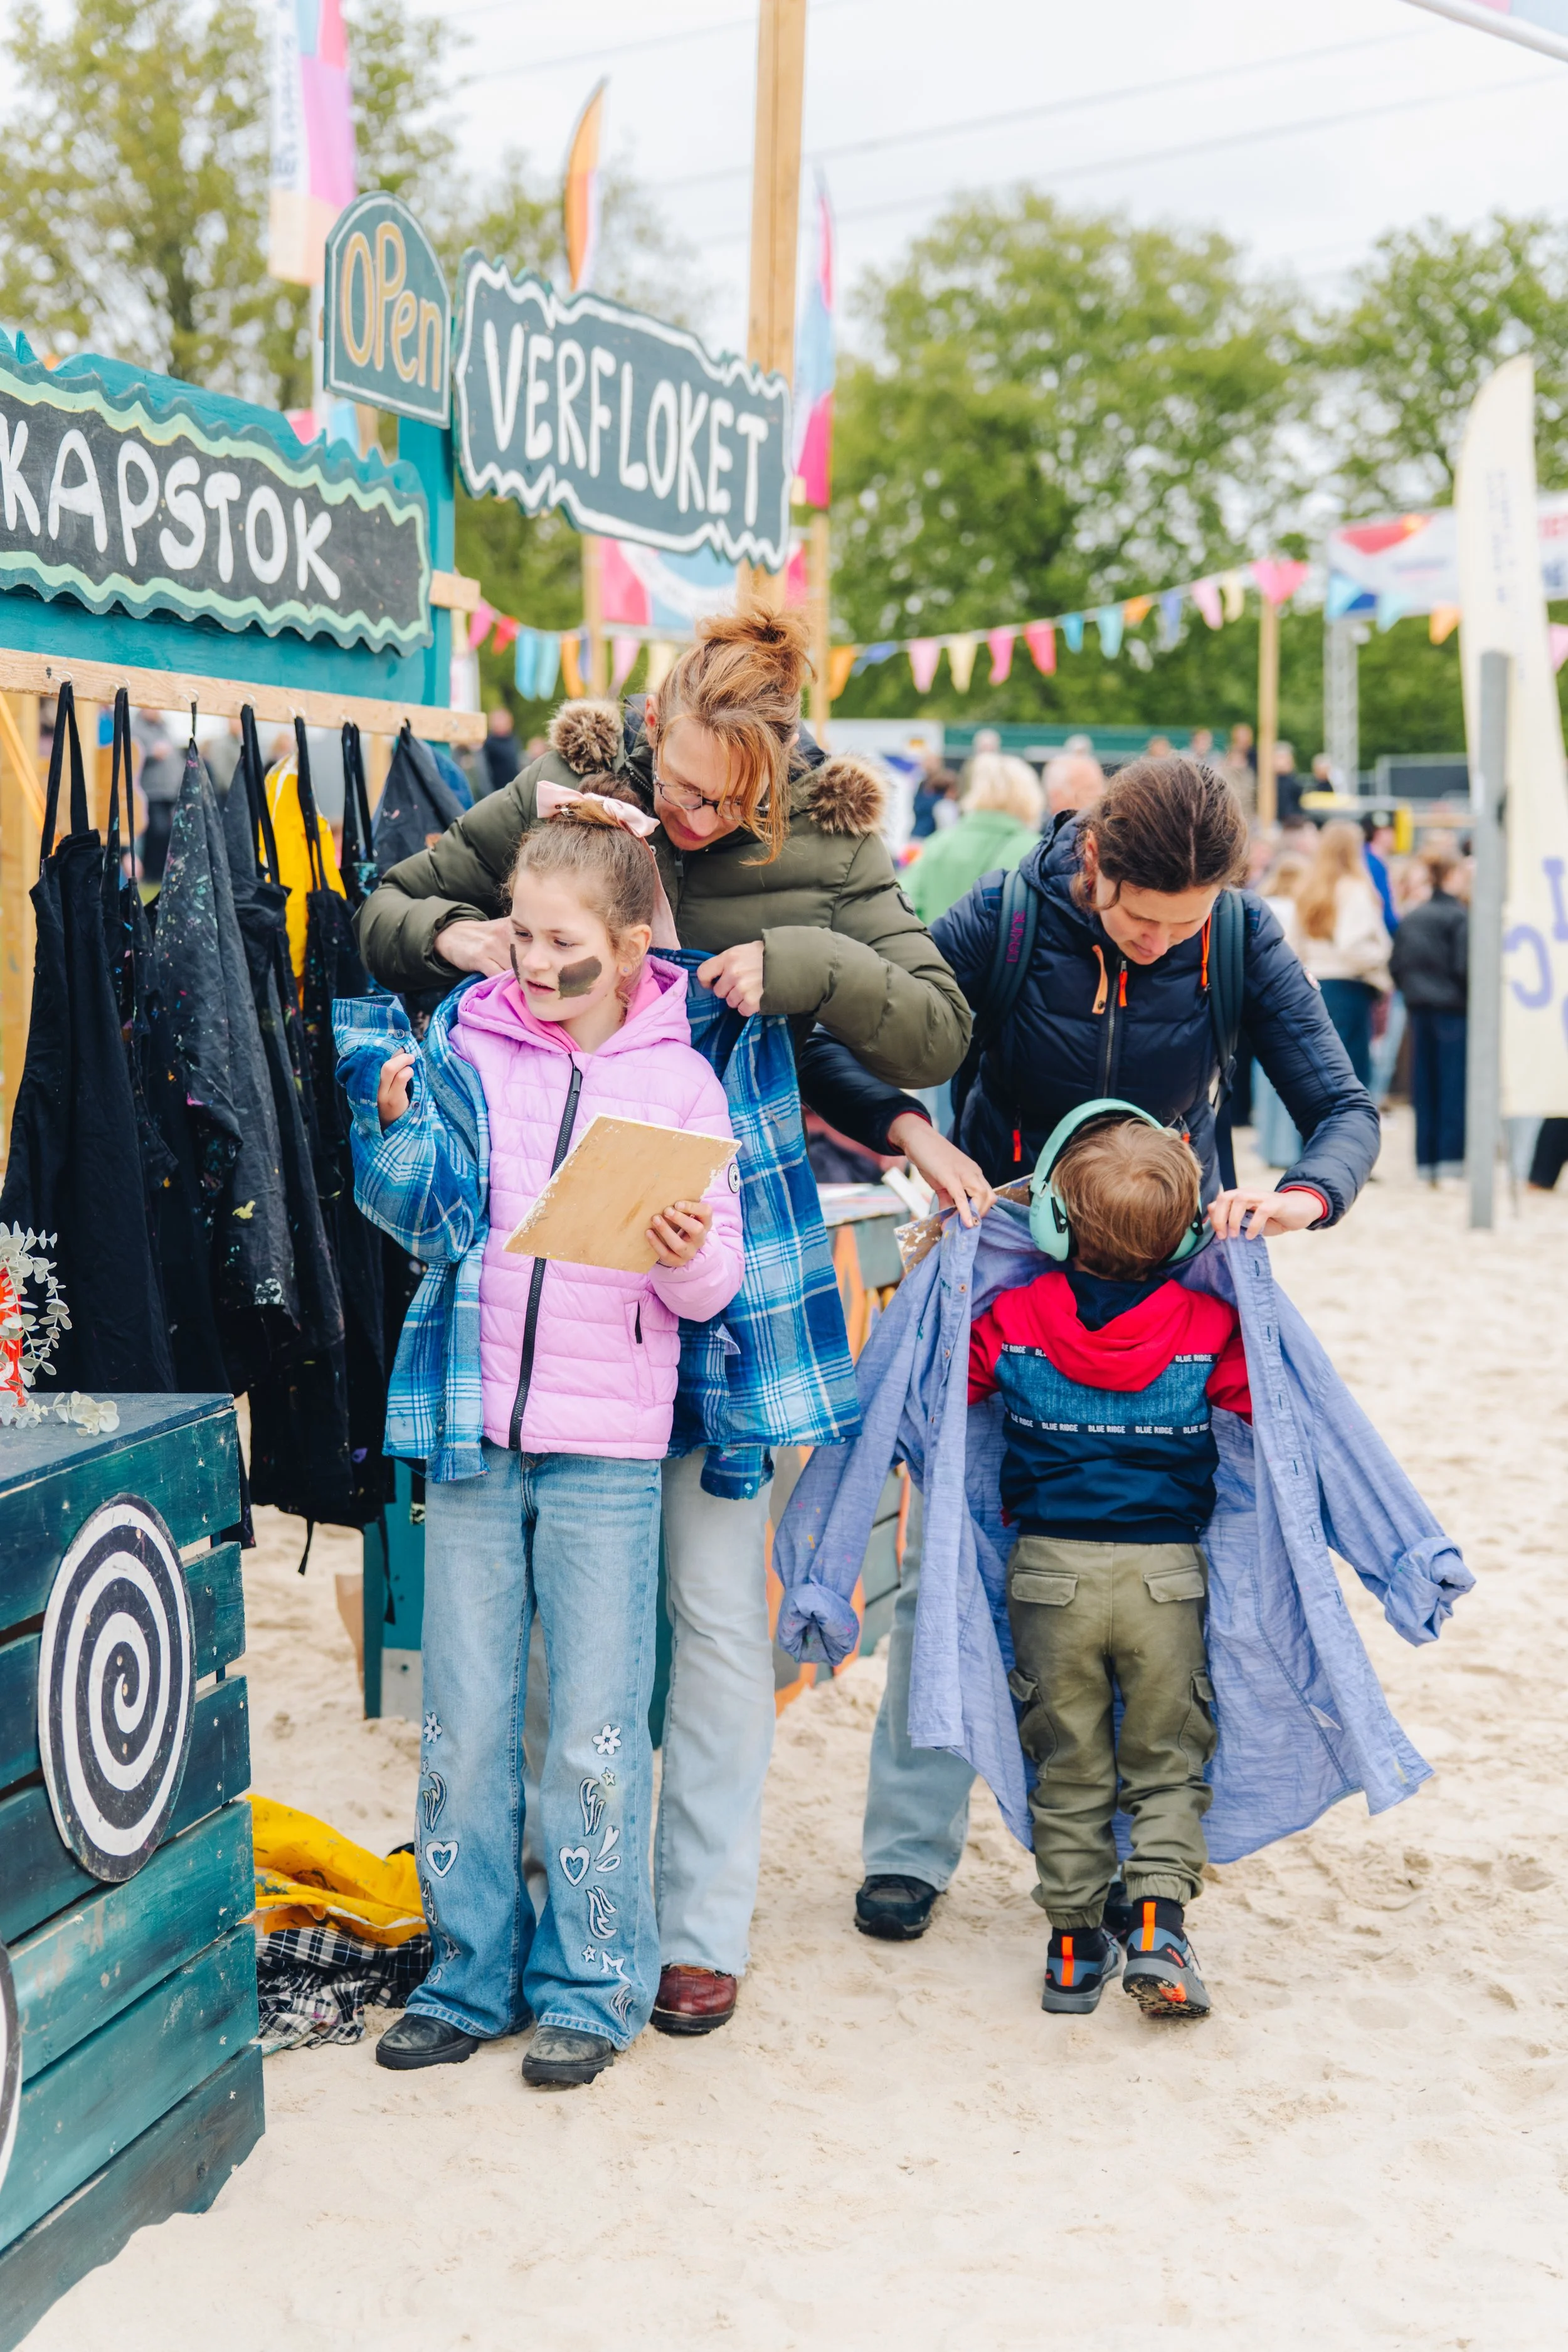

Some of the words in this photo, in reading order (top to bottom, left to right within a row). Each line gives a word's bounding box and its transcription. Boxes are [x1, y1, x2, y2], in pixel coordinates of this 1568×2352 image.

[484, 319, 769, 527] VERFLOKET
[0, 411, 341, 600] KAPSTOK
[1005, 909, 1025, 962] DAKINE
[1009, 1345, 1026, 1354] RIDGE
[1035, 1348, 1046, 1357] BL
[1019, 1417, 1034, 1428] RIDGE
[1042, 1422, 1058, 1431] BLUE
[1059, 1423, 1078, 1432] RIDGE
[1106, 1425, 1126, 1434] RIDGE
[1135, 1426, 1153, 1434] BLUE
[1183, 1425, 1199, 1434] BLUE
